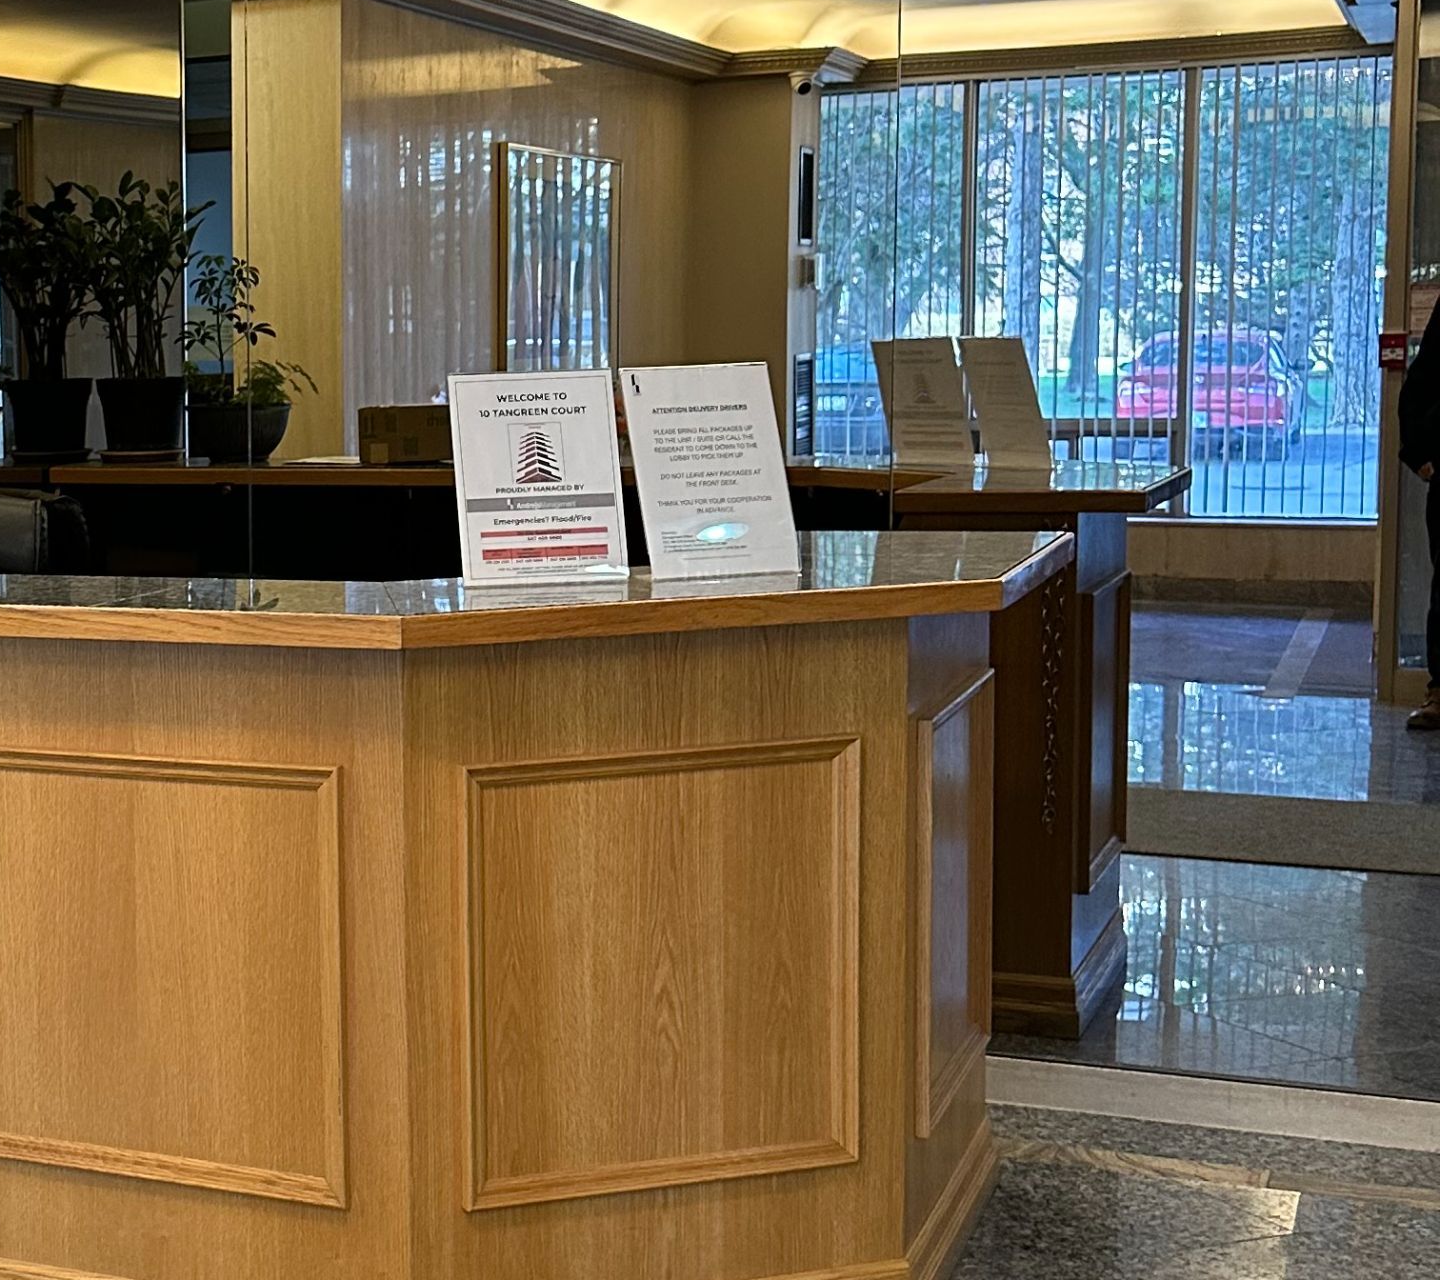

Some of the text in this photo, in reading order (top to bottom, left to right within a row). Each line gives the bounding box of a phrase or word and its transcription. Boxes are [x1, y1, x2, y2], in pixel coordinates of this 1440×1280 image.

[496, 391, 568, 403] WELCOME TO
[479, 405, 587, 418] 10 TANGREEN COURT
[652, 406, 687, 414] ATTENTION
[688, 405, 719, 413] DELIVERY
[495, 483, 584, 494] PROUDLY MANAGED BY
[493, 513, 592, 526] Emergencies? Flood/Fire
